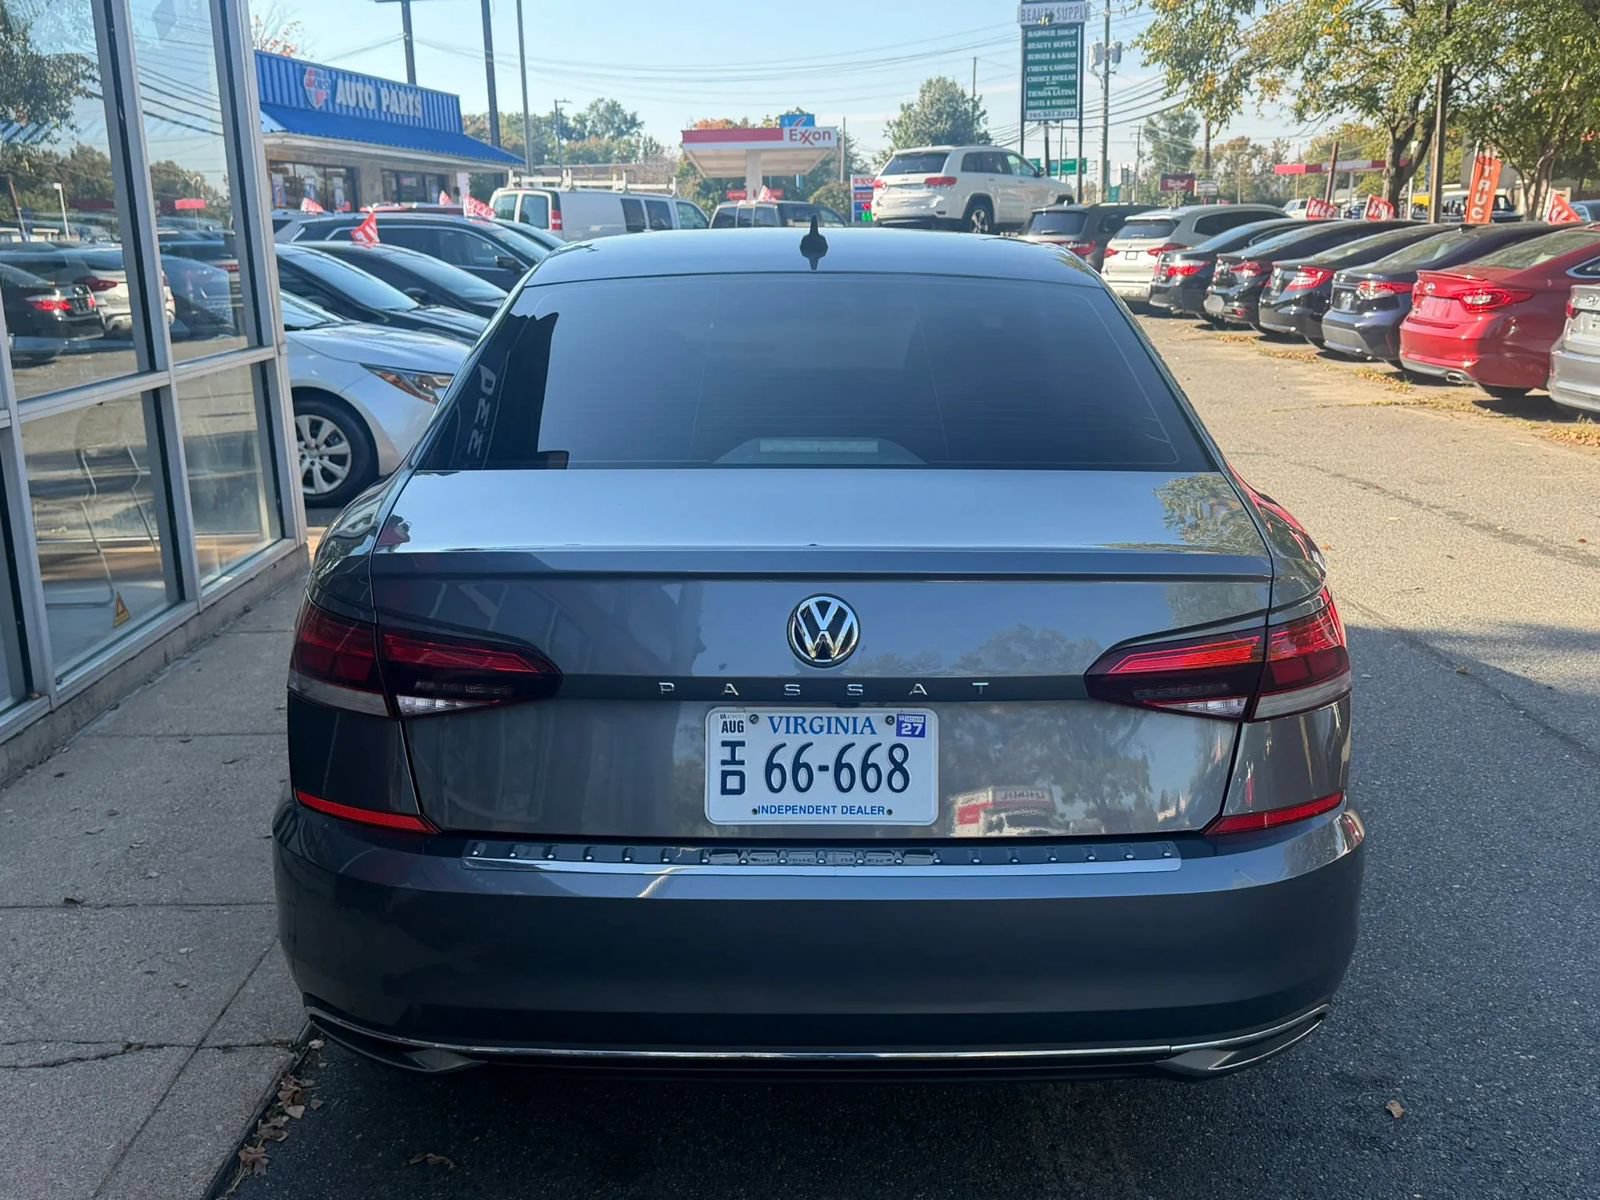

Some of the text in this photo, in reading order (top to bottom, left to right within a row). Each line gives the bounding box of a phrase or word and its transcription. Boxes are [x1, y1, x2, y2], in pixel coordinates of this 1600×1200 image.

[1056, 5, 1089, 20] SUPPLY
[336, 79, 376, 110] AUTO
[381, 87, 421, 118] PARTS
[789, 129, 831, 146] Exxon
[658, 681, 990, 698] PASSAT
[721, 720, 744, 733] AUG
[767, 716, 878, 735] VIRGINIA
[901, 722, 923, 735] 27
[764, 742, 910, 793] 66-668
[757, 805, 885, 815] INDEPENDENT DEALER
